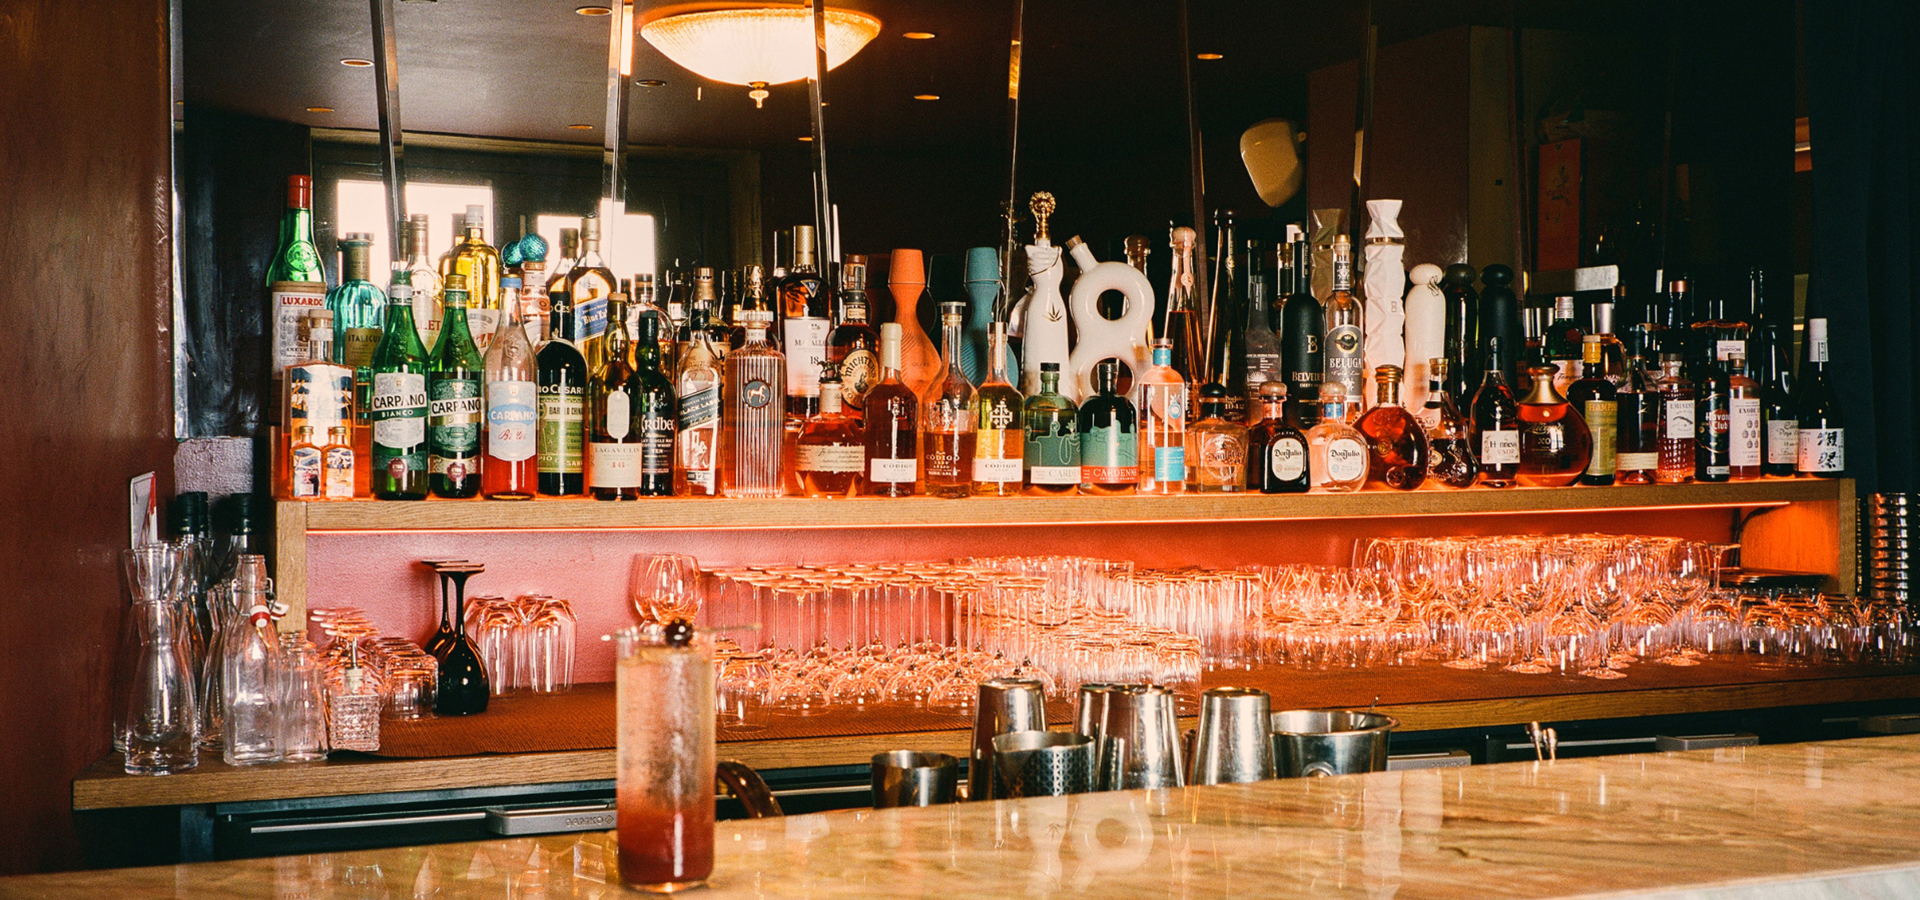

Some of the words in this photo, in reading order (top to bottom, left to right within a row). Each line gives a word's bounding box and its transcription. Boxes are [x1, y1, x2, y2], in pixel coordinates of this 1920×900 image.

[282, 297, 323, 306] LUXARDO
[1329, 358, 1362, 368] BELUGA
[373, 393, 426, 409] CARPANO
[381, 409, 414, 418] BIANCO
